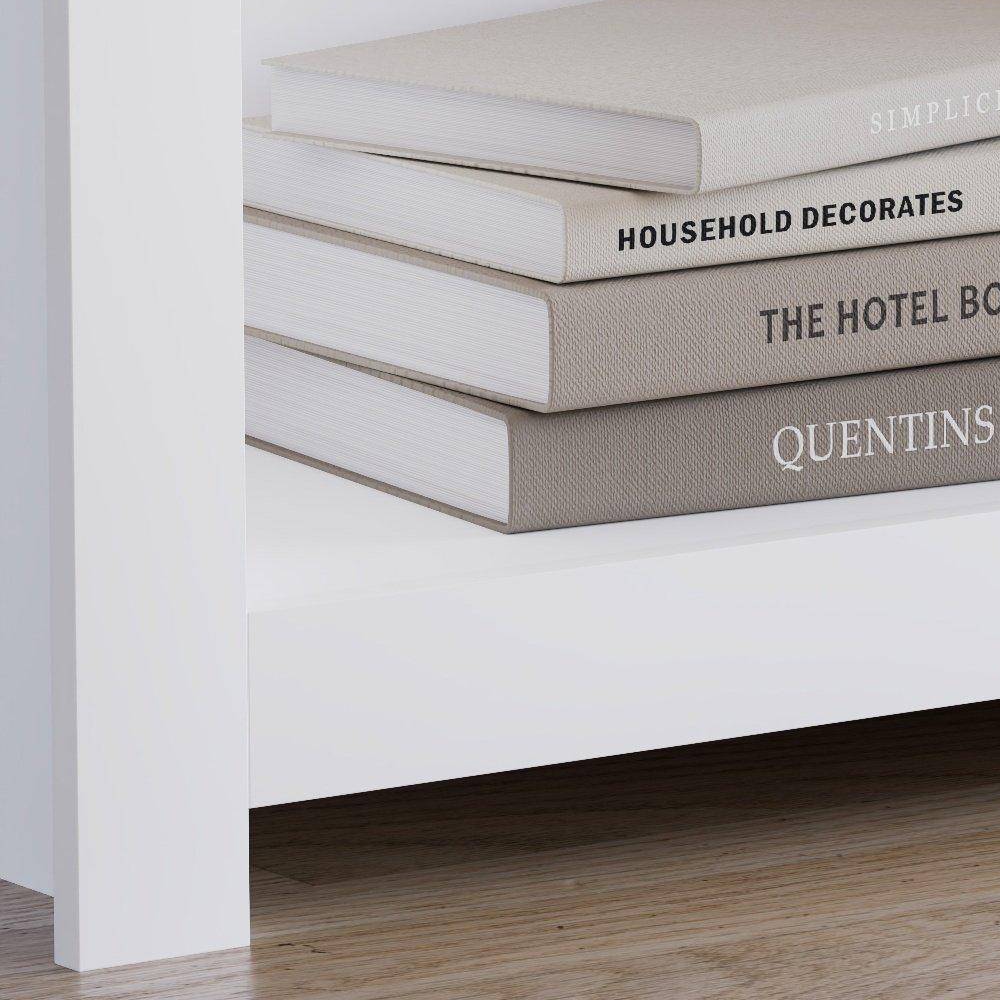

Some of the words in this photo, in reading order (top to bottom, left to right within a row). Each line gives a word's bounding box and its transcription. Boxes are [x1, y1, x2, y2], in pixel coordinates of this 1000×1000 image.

[618, 209, 793, 252] HOUSEHOLD
[802, 189, 964, 230] DECORATES
[760, 303, 825, 344] THE
[838, 289, 949, 336] HOTEL
[772, 404, 996, 472] QUENTINS
